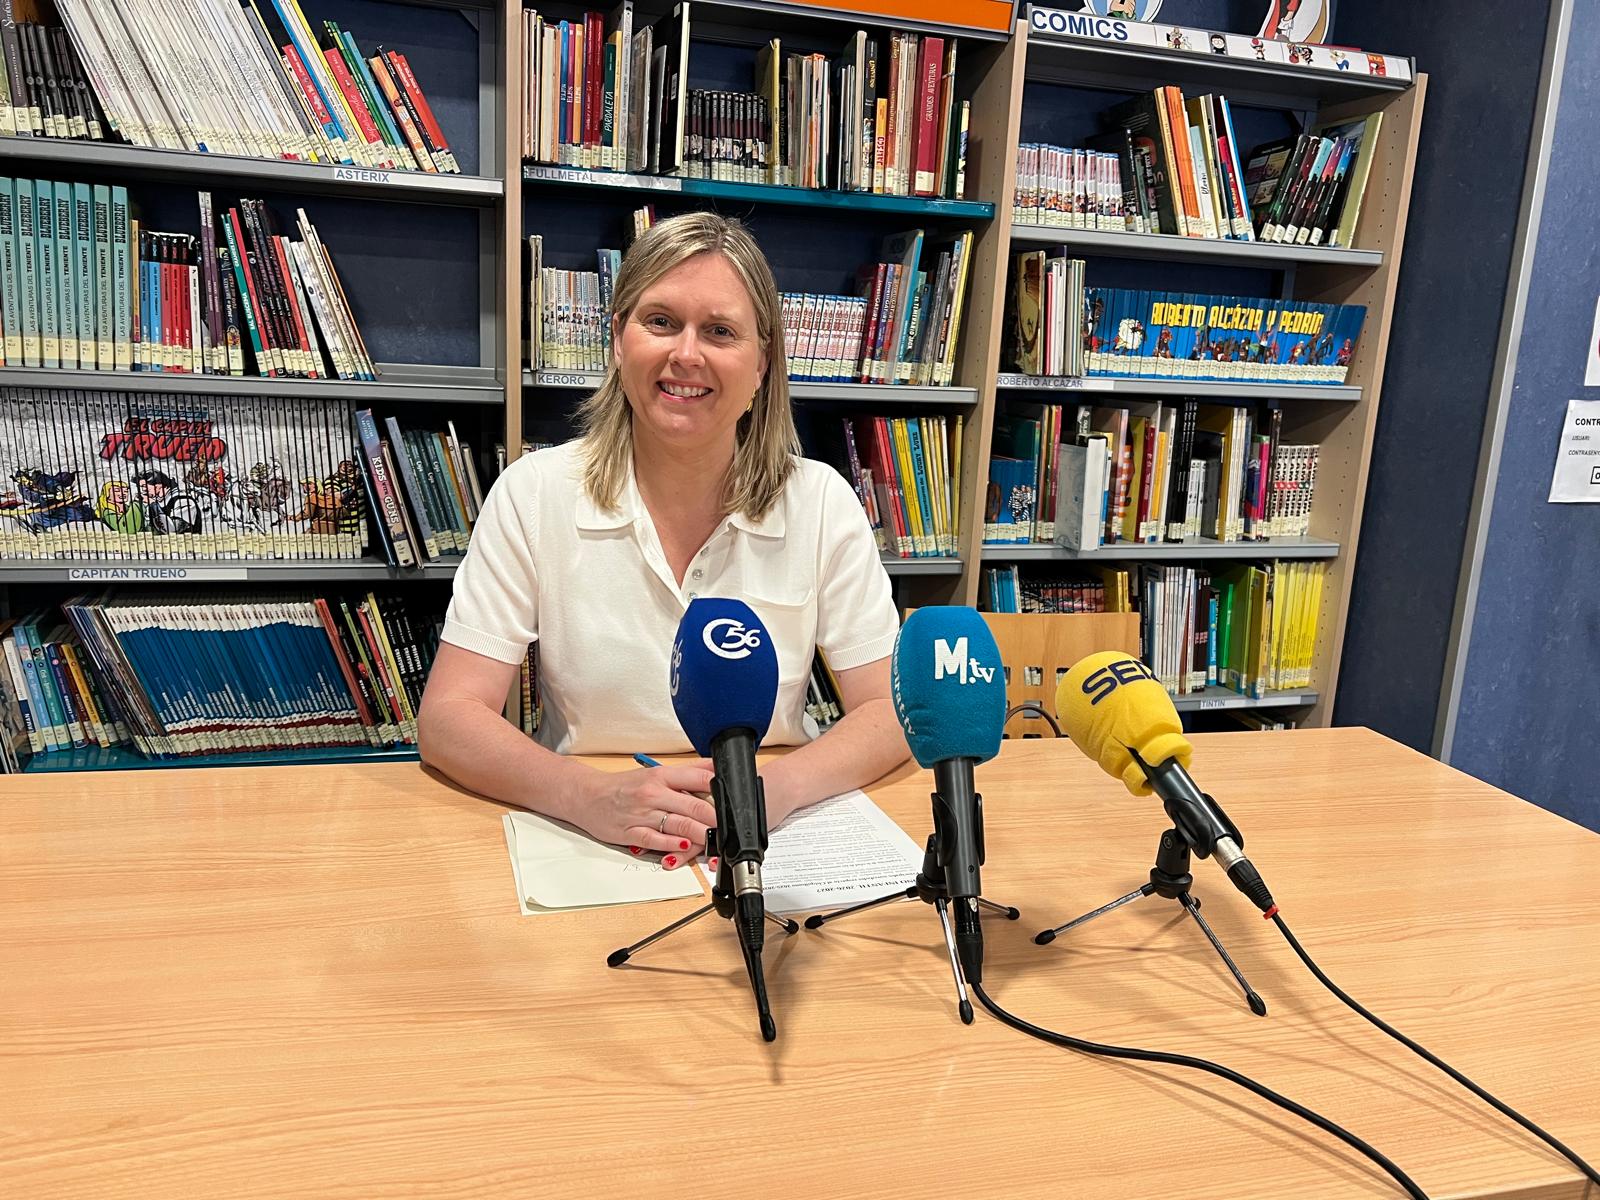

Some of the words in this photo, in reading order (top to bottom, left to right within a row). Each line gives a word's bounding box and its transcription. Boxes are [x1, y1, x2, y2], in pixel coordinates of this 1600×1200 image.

[1031, 9, 1129, 42] COMICS
[929, 63, 937, 94] AVENTURAS
[603, 91, 614, 133] PARDALETA
[925, 95, 935, 122] GRANDES
[876, 136, 885, 166] JALISCO
[336, 169, 389, 183] ASTERIX
[528, 167, 597, 183] FULLMETAL
[0, 193, 12, 235] BLUEBERRY
[20, 195, 32, 236] BLUEBERRY
[39, 197, 51, 238] BLUEBERRY
[58, 199, 70, 240] BLUEBERRY
[77, 200, 89, 241] BLUEBERRY
[96, 202, 107, 243] BLUEBERRY
[114, 203, 126, 243] BLUEBERRY
[1266, 309, 1277, 331] Y
[538, 375, 585, 385] KERORO
[997, 377, 1039, 386] ROBERTO
[371, 456, 387, 482] KIDS
[384, 496, 399, 524] GUNS
[133, 568, 187, 579] TRUENO
[702, 618, 761, 660] C56
